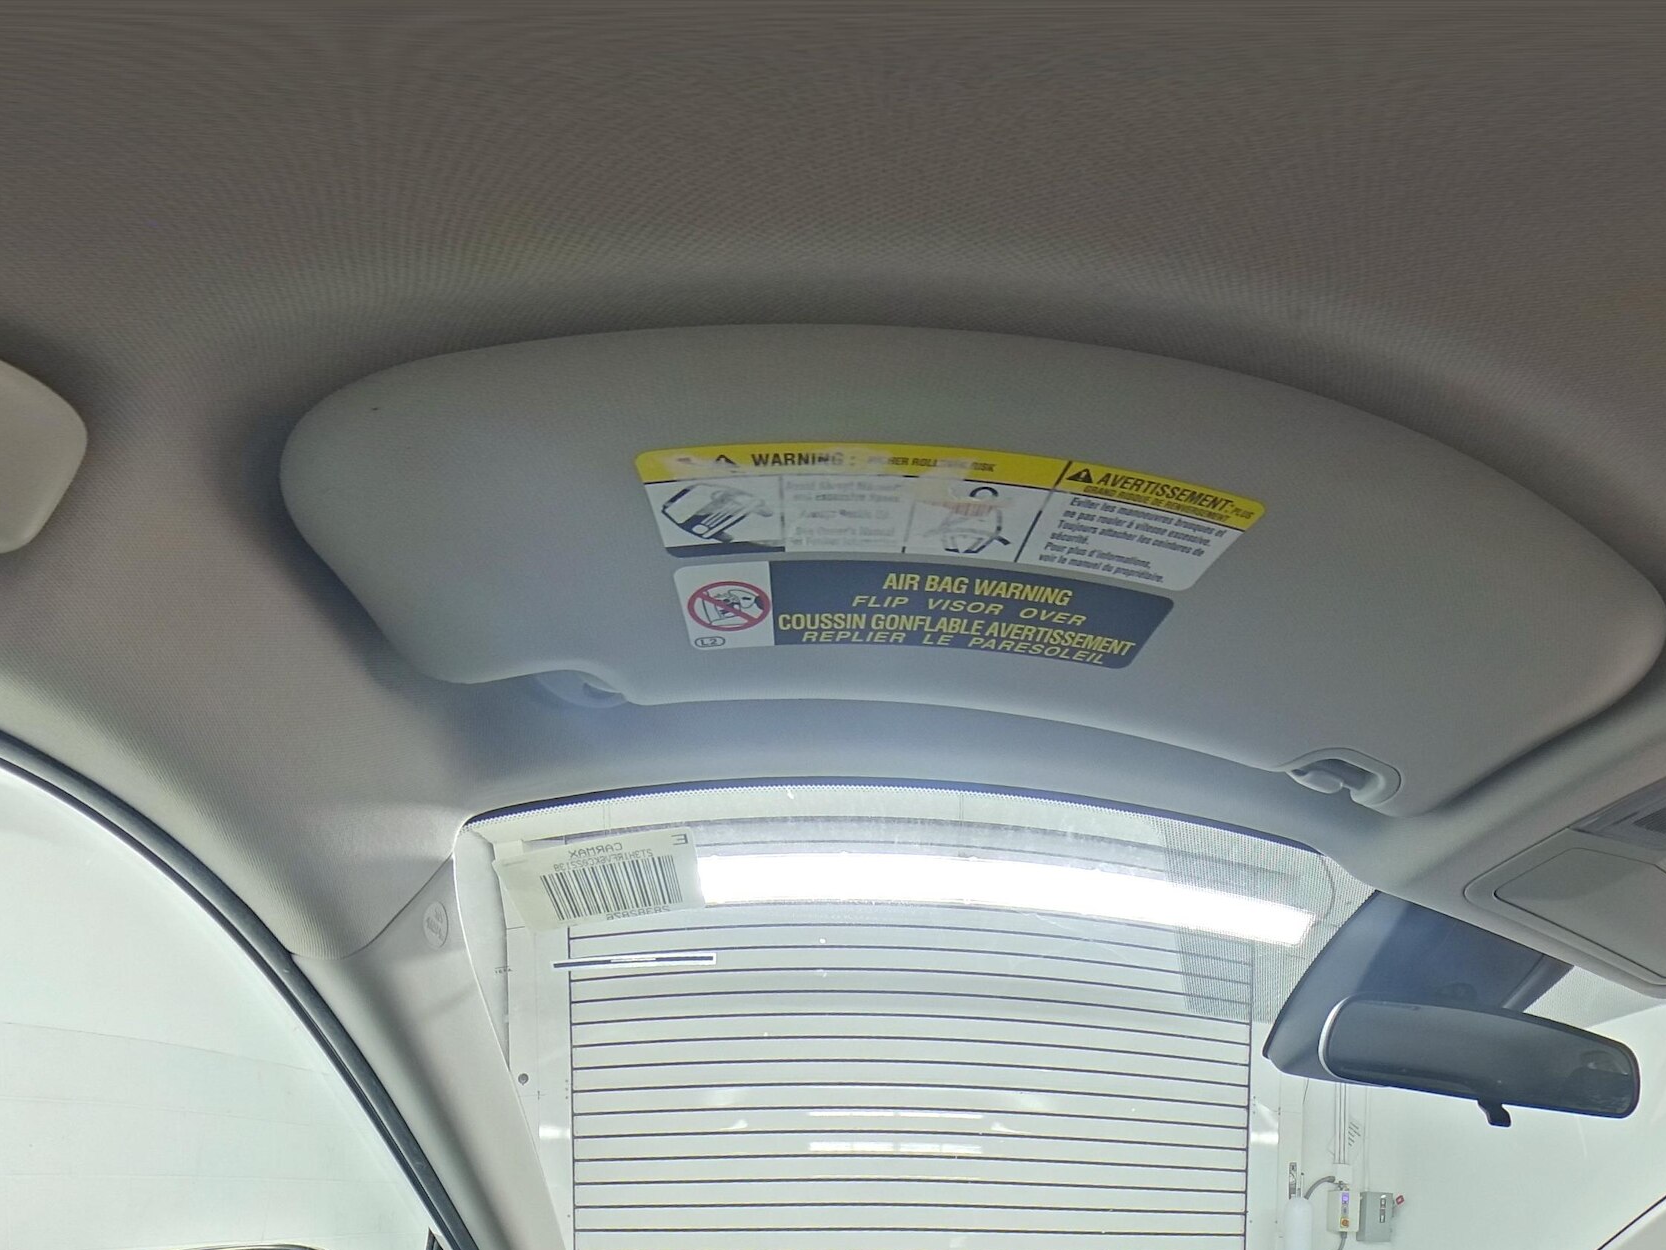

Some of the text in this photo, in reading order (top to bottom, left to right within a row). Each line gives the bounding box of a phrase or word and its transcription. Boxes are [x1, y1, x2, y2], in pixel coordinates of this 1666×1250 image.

[883, 573, 1073, 606] AIR BAG WARNING
[852, 595, 1087, 626] FLIP VISOR OVER
[700, 638, 718, 647] L2
[778, 613, 1136, 656] COUSSIN GONFLABLE AVERTISSEMENT
[802, 631, 1105, 665] REPLIER LE PARESOLEIL
